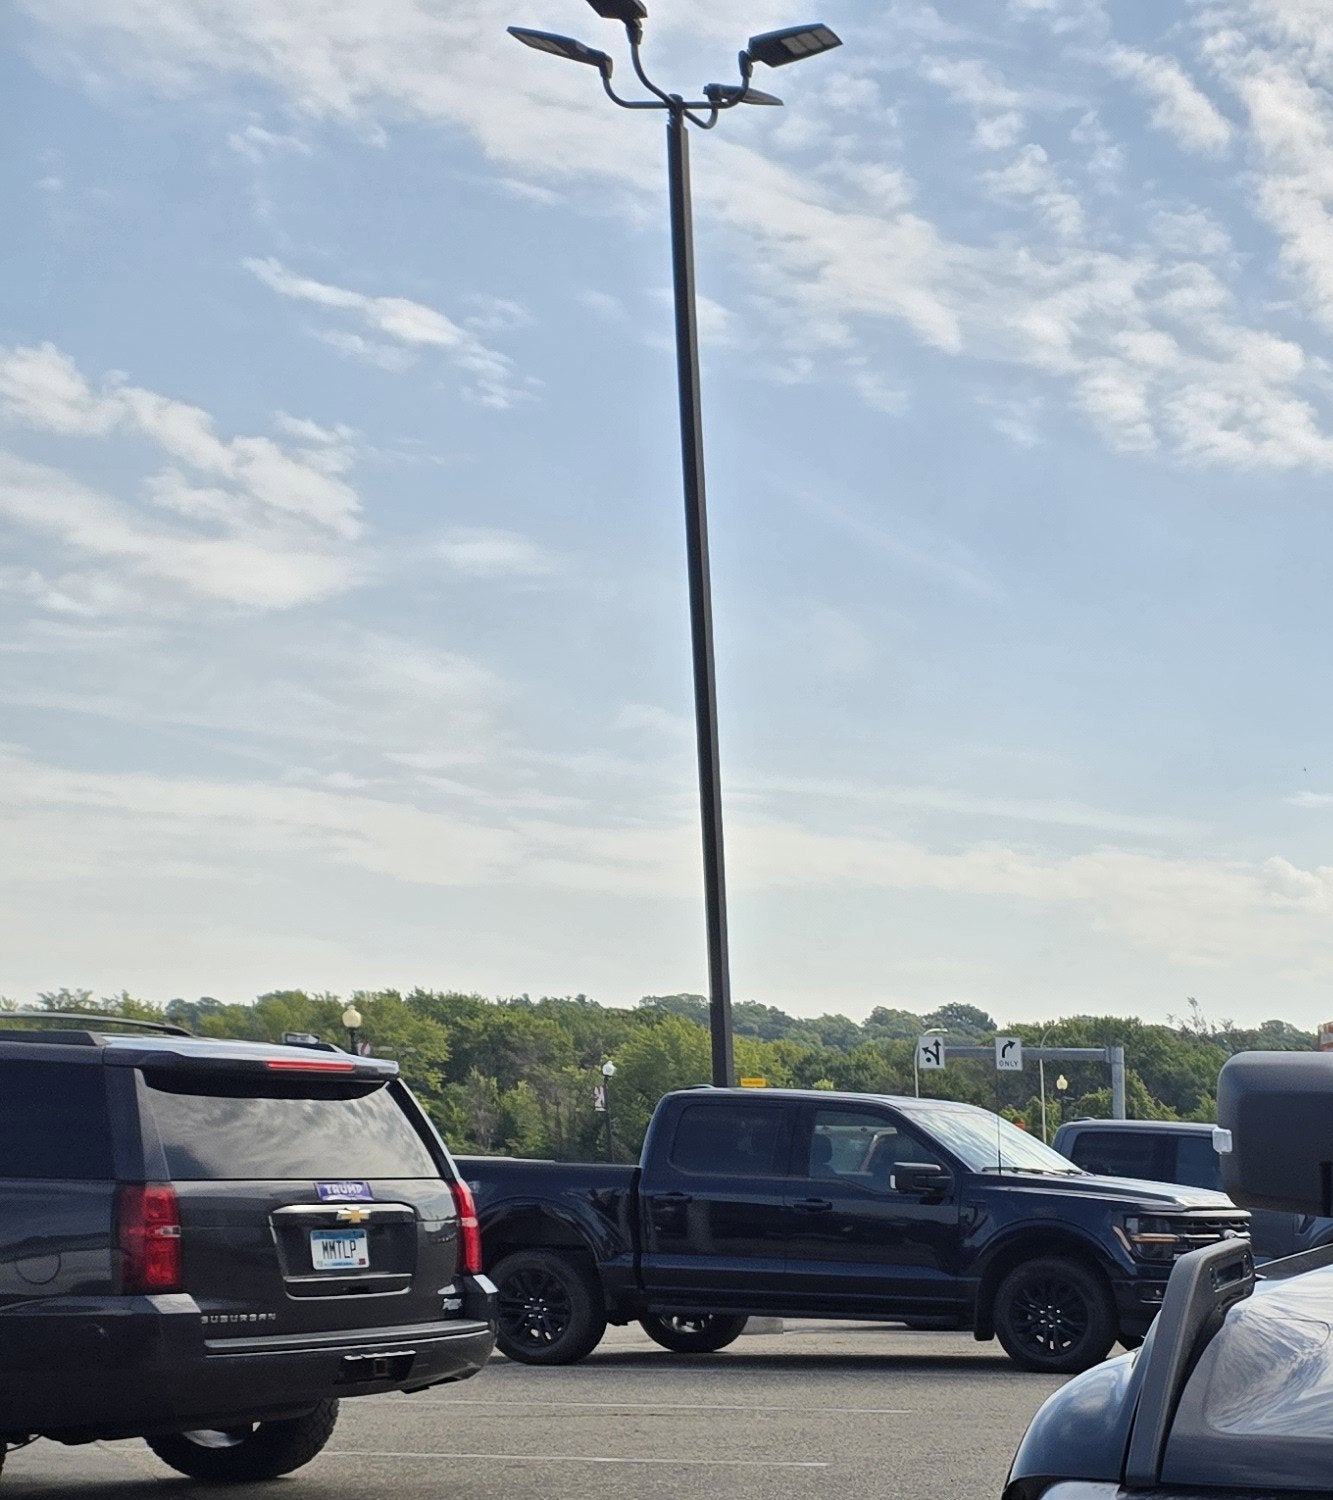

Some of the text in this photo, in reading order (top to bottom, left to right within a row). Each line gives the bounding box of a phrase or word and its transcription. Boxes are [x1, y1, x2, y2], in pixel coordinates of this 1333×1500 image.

[998, 1060, 1019, 1068] ONLY
[324, 1184, 363, 1195] TRUMP
[201, 1313, 276, 1324] SUBURBAN
